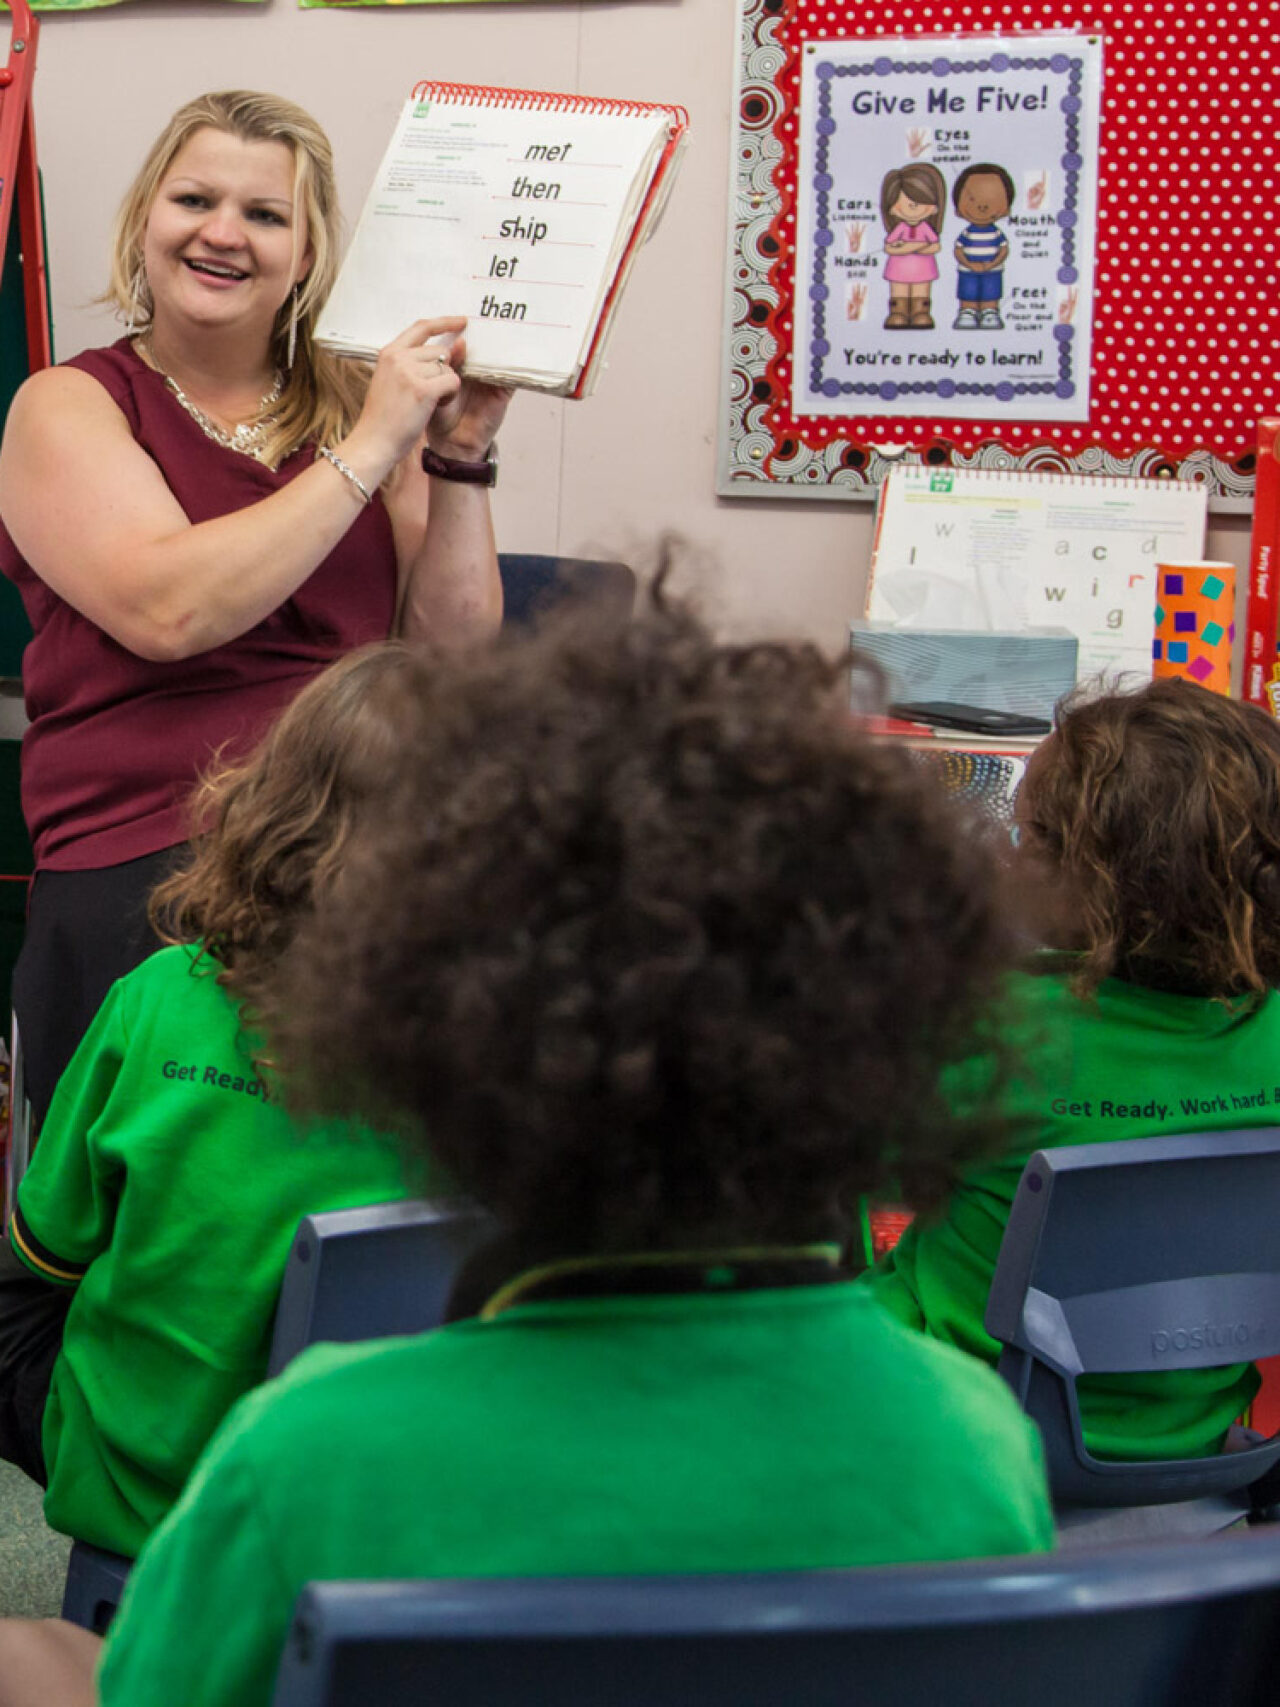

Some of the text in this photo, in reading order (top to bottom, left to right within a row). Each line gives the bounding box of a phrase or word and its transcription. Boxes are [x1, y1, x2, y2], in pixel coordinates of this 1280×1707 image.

[852, 85, 1048, 115] Give Me Five!
[934, 129, 970, 142] Eyes
[525, 142, 573, 162] met
[511, 176, 561, 200] then
[837, 199, 872, 210] Ears
[1008, 214, 1056, 226] Mouth
[499, 216, 548, 246] ship
[489, 255, 518, 279] let
[834, 255, 878, 267] Hands
[1012, 287, 1047, 299] Feet
[480, 295, 527, 320] than
[843, 348, 1043, 368] You're ready to learn!
[1092, 545, 1108, 561] c
[162, 1060, 197, 1081] Get
[1051, 1098, 1092, 1117] Get
[1100, 1100, 1174, 1121] Ready.
[1180, 1095, 1229, 1116] Work
[1230, 1088, 1271, 1110] hard.
